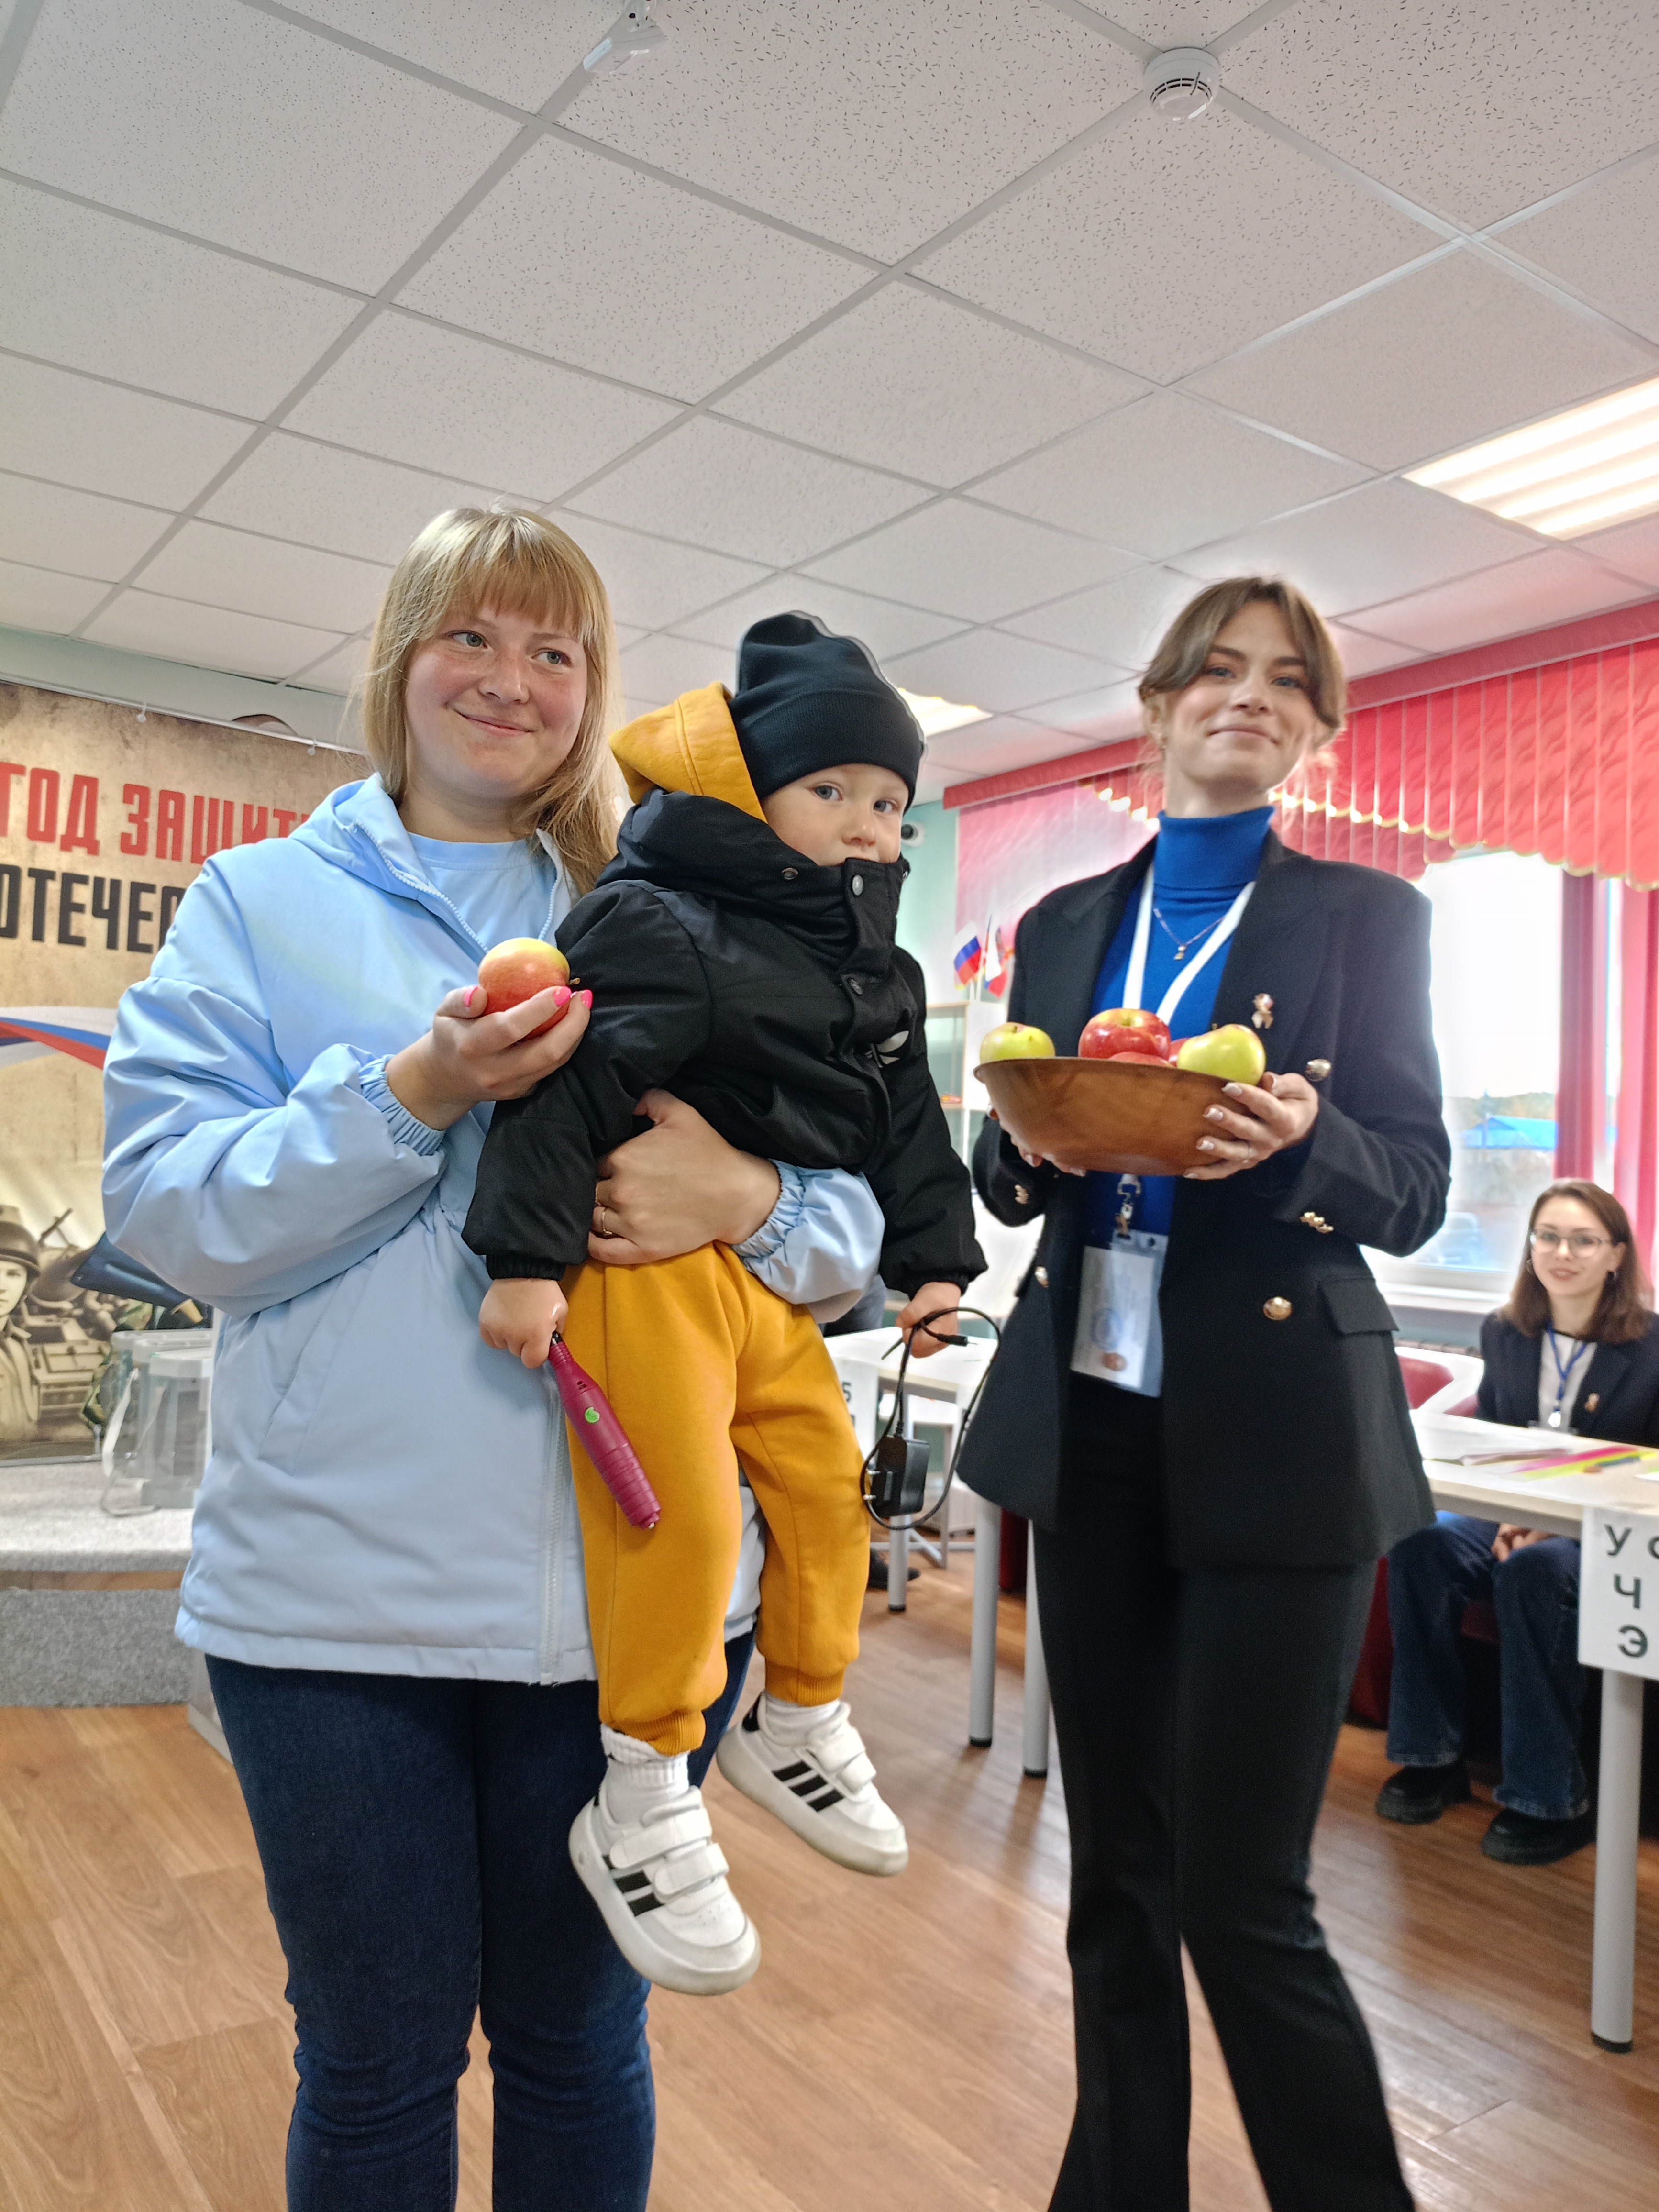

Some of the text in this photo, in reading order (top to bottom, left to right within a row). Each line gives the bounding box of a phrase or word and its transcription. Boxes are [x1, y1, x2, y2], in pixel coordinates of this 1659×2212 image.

[0, 761, 312, 866] ГОД ЗАЩИТ
[1614, 1573, 1641, 1609] Ч
[1617, 1624, 1648, 1659] Э
